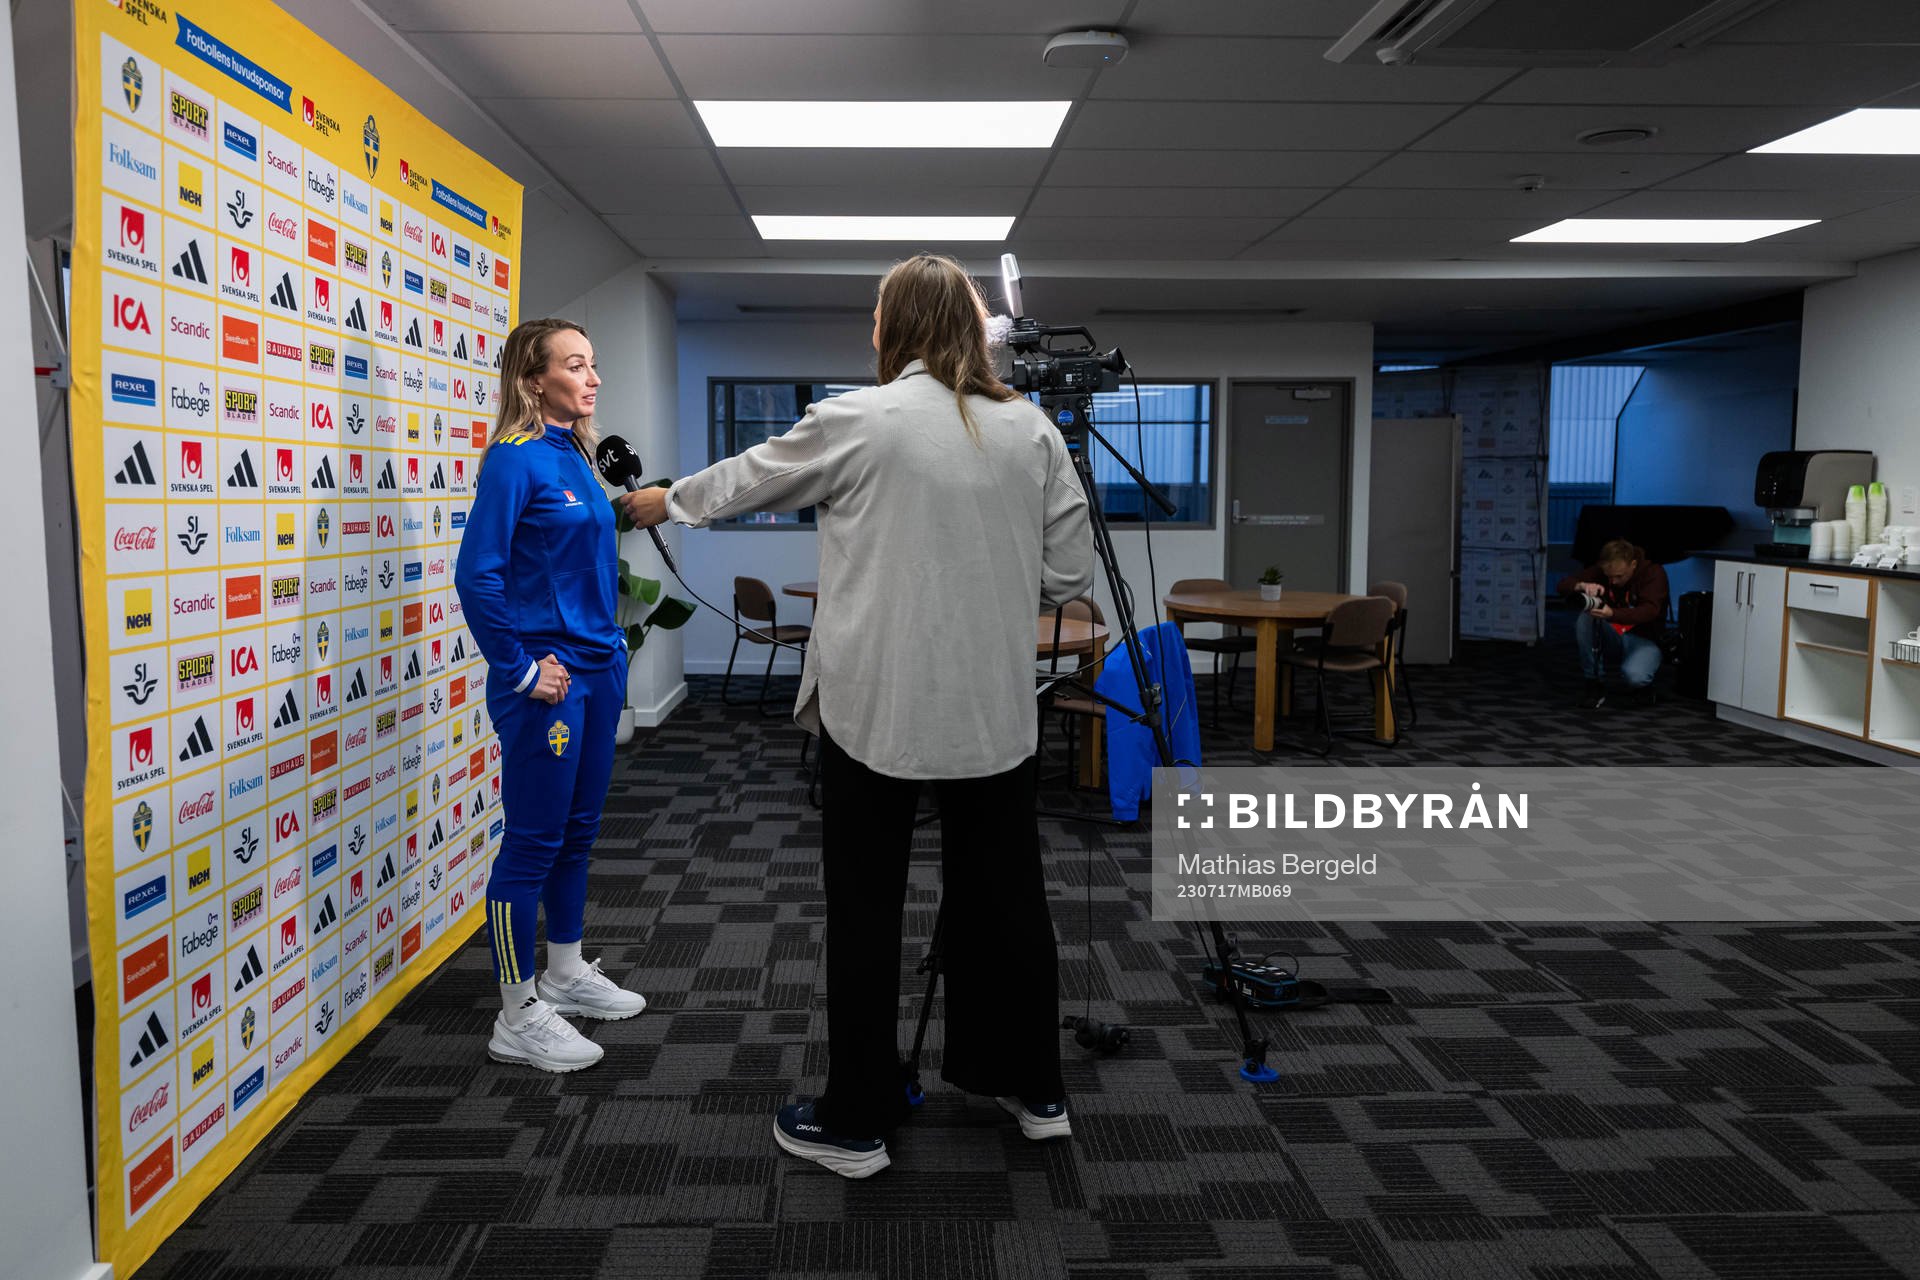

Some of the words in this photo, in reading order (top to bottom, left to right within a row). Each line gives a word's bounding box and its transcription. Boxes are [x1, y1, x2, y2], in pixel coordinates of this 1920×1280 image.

[126, 4, 148, 25] SPEL
[186, 28, 231, 68] Fotbollens
[232, 56, 285, 100] huvudsponsor
[171, 92, 208, 129] SPORT
[316, 109, 340, 133] SVENSKA
[174, 118, 208, 138] BLADET
[316, 123, 329, 136] SPEL
[109, 143, 156, 180] Folksam
[267, 151, 298, 178] Scandic
[308, 170, 334, 202] Fabege
[235, 190, 245, 209] SJ
[344, 190, 368, 215] Folksam
[346, 243, 367, 266] SPORT
[432, 232, 446, 258] ICA
[108, 248, 140, 267] SVENSKA
[142, 260, 158, 273] SPEL
[222, 284, 246, 299] SVENSKA
[247, 292, 259, 303] SPEL
[113, 294, 152, 335] ICA
[308, 311, 326, 322] SVENSKA
[327, 318, 336, 326] SPEL
[171, 316, 210, 340] Scandic
[225, 334, 249, 346] Swedbank
[266, 342, 302, 361] BAUHAUS
[310, 343, 334, 366] SPORT
[376, 366, 397, 382] Scandic
[404, 373, 423, 392] Fabege
[454, 378, 466, 400] ICA
[171, 387, 210, 417] Fabege
[226, 390, 257, 413] SPORT
[269, 403, 300, 420] Scandic
[352, 404, 359, 418] SJ
[227, 412, 256, 420] BLADET
[312, 402, 333, 429] ICA
[598, 448, 620, 472] svt
[171, 483, 198, 492] SVENSKA
[200, 484, 213, 492] SPEL
[188, 516, 198, 534] SJ
[226, 527, 260, 543] Folksam
[343, 522, 370, 534] BAUHAUS
[377, 515, 394, 538] ICA
[272, 578, 299, 598] SPORT
[310, 579, 336, 594] Scandic
[345, 574, 367, 592] Fabege
[174, 594, 215, 615] Scandic
[228, 593, 252, 602] Swedbank
[273, 596, 299, 605] BLADET
[430, 602, 443, 624] ICA
[345, 627, 368, 642] Folksam
[231, 646, 258, 676] ICA
[272, 644, 300, 663] Fabege
[135, 663, 146, 682] SJ
[179, 655, 213, 681] SPORT
[180, 676, 214, 689] BLADET
[309, 710, 328, 721] SVENSKA
[328, 705, 338, 714] SPEL
[402, 705, 423, 720] BAUHAUS
[227, 737, 250, 751] SVENSKA
[252, 733, 263, 743] SPEL
[270, 754, 304, 777] BAUHAUS
[375, 765, 396, 784] Scandic
[403, 754, 421, 773] Fabege
[117, 774, 148, 790] SVENSKA
[150, 767, 166, 778] SPEL
[229, 775, 263, 799] Folksam
[344, 778, 370, 800] BAUHAUS
[313, 789, 336, 816] SPORT
[242, 827, 250, 844] SJ
[276, 810, 300, 843] ICA
[354, 824, 360, 839] SJ
[232, 887, 263, 921] SPORT
[451, 891, 464, 915] ICA
[377, 905, 393, 933] ICA
[182, 925, 218, 958] Fabege
[345, 929, 368, 955] Scandic
[273, 953, 293, 972] SVENSKA
[294, 944, 304, 958] SPEL
[127, 960, 157, 983] Swedbank
[272, 980, 305, 1012] BAUHAUS
[345, 981, 367, 1008] Fabege
[182, 1016, 208, 1039] SVENSKA
[209, 1005, 222, 1019] SPEL
[275, 1036, 302, 1069] Scandic
[183, 1105, 225, 1149] BAUHAUS
